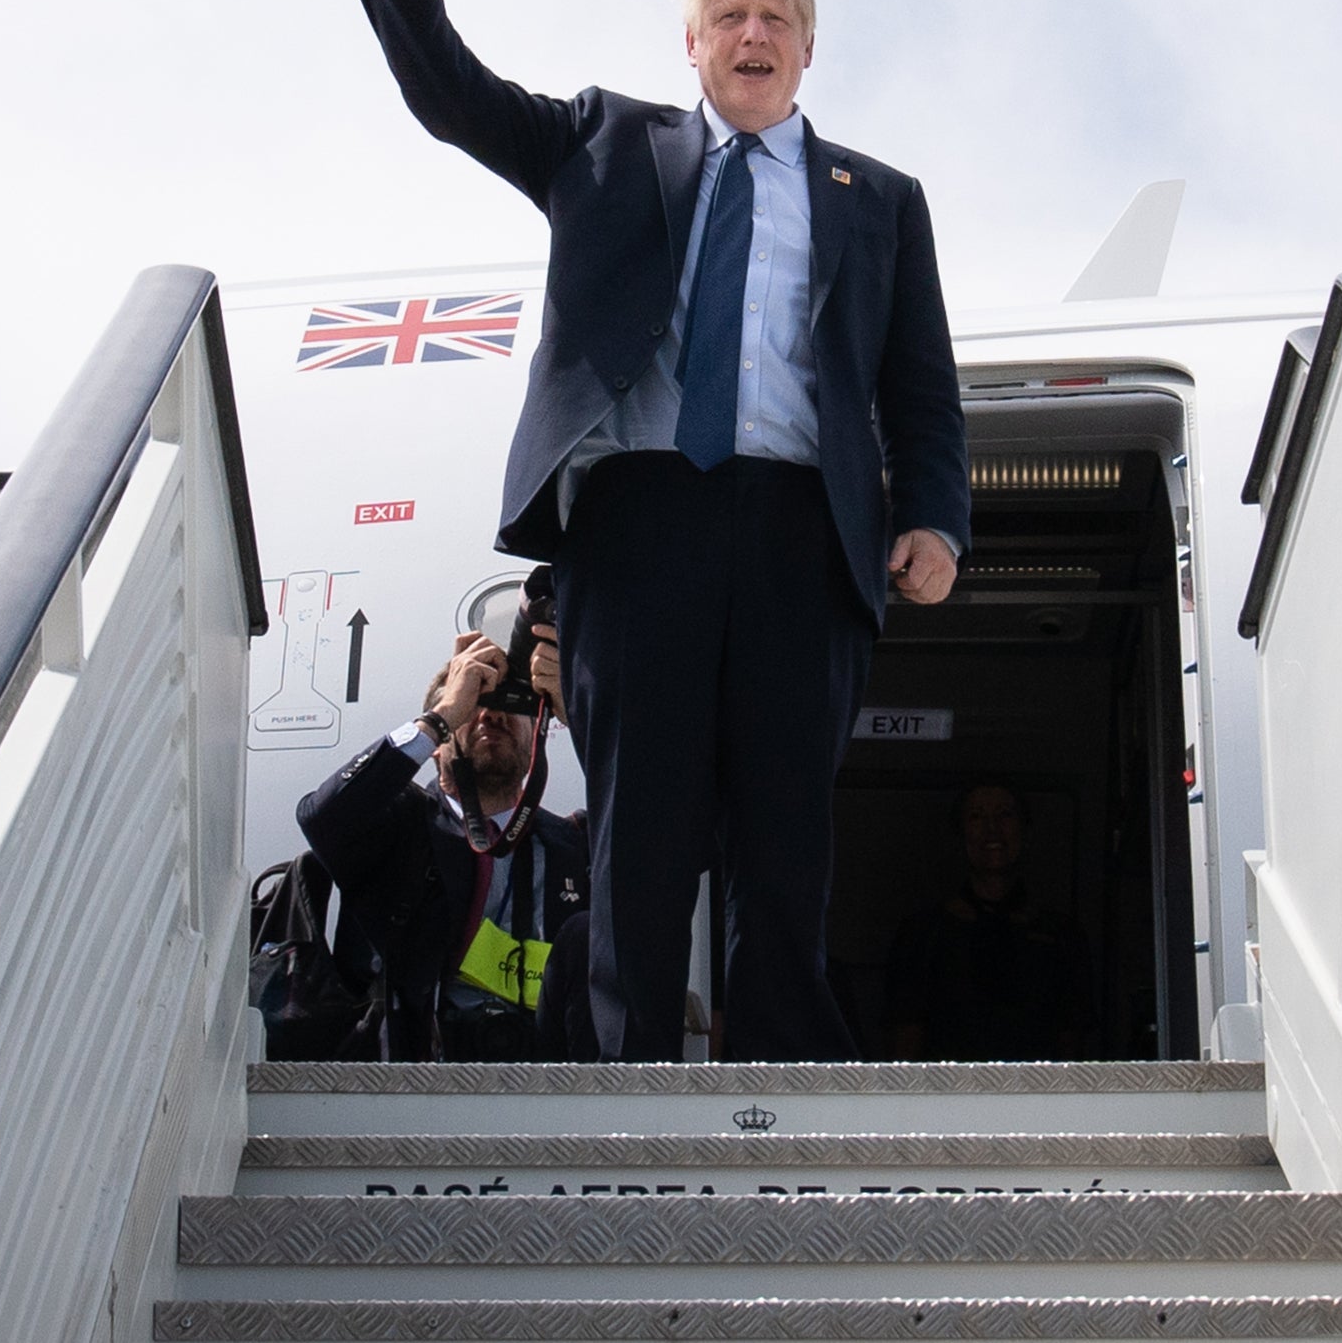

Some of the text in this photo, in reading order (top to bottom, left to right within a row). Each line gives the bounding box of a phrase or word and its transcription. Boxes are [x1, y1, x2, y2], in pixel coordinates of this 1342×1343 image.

[359, 504, 410, 521] EXIT
[872, 716, 925, 734] EXIT
[506, 806, 531, 841] Canon
